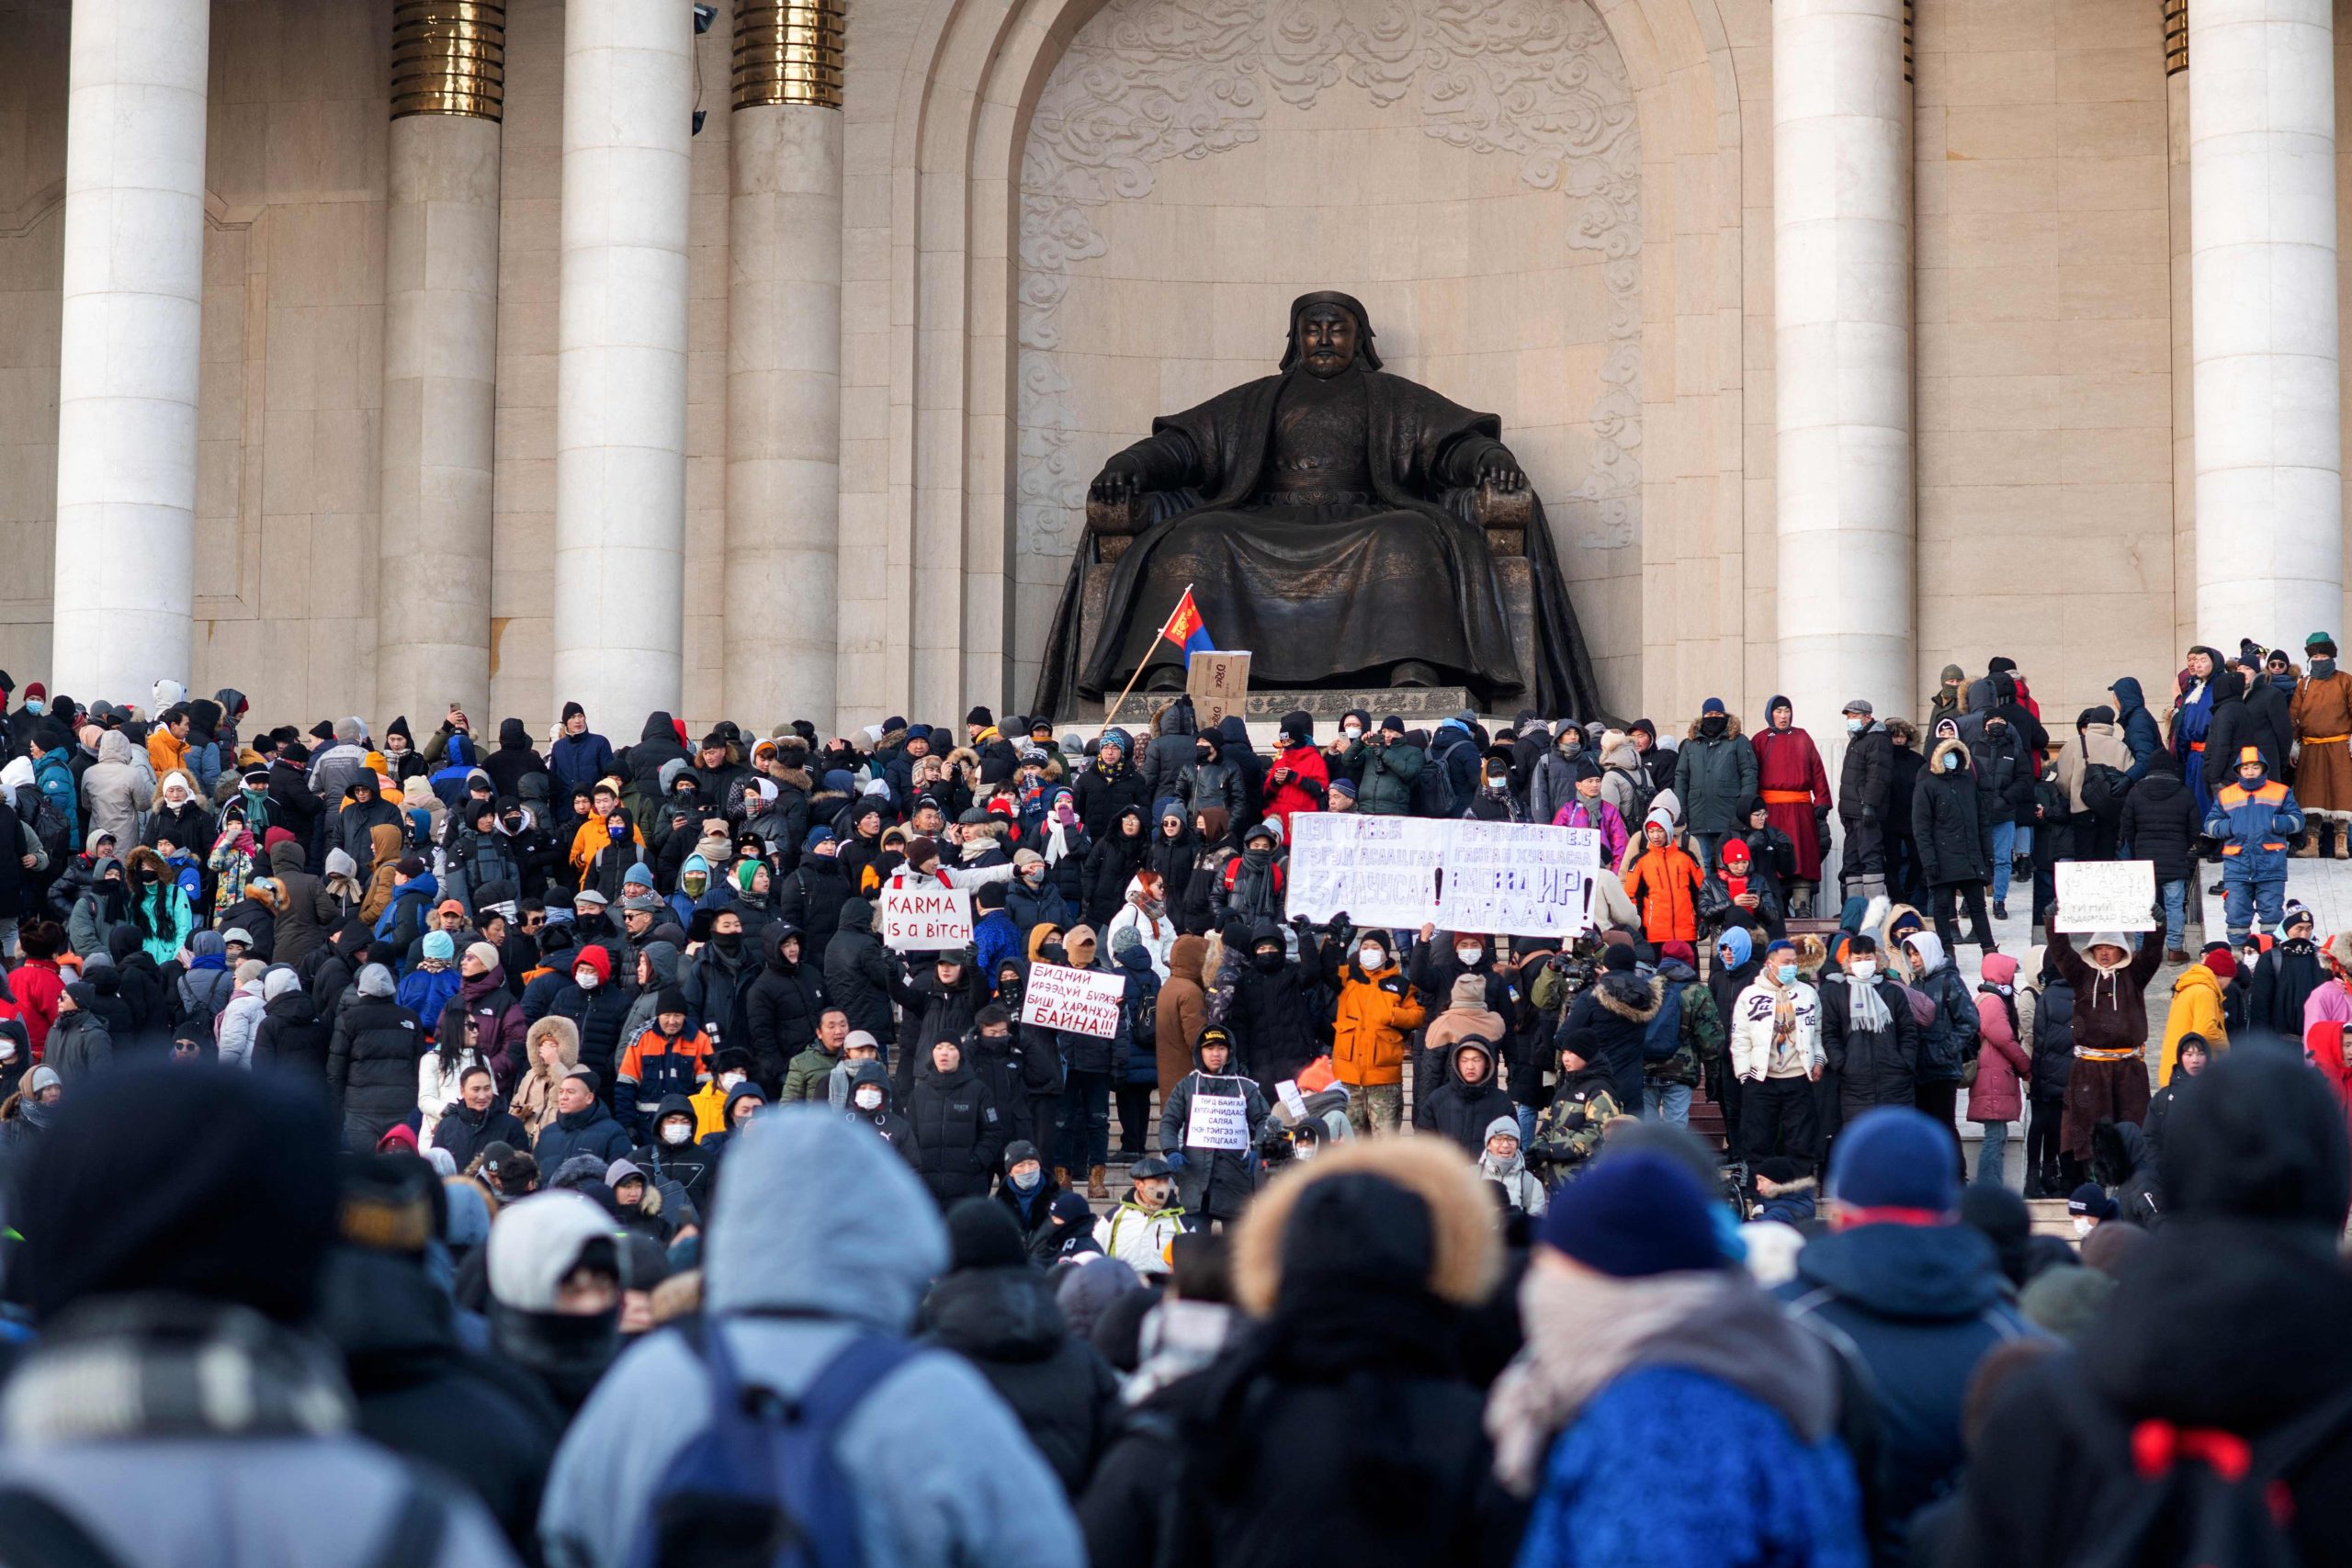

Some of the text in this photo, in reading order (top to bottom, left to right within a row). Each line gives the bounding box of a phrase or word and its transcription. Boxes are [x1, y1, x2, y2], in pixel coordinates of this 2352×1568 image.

[1297, 818, 1338, 841] ЦЭГ
[888, 896, 956, 914] KARMA
[1034, 965, 1091, 985] БИДНИЙ
[1027, 994, 1118, 1021] БИШ ХАРАНХУЙ
[1086, 990, 1118, 1006] БҮРХЭ
[1035, 1008, 1114, 1036] БАЙНА!!!
[1208, 1117, 1233, 1125] САЛЯА
[1204, 1136, 1238, 1145] ТУЛЦГААЯ
